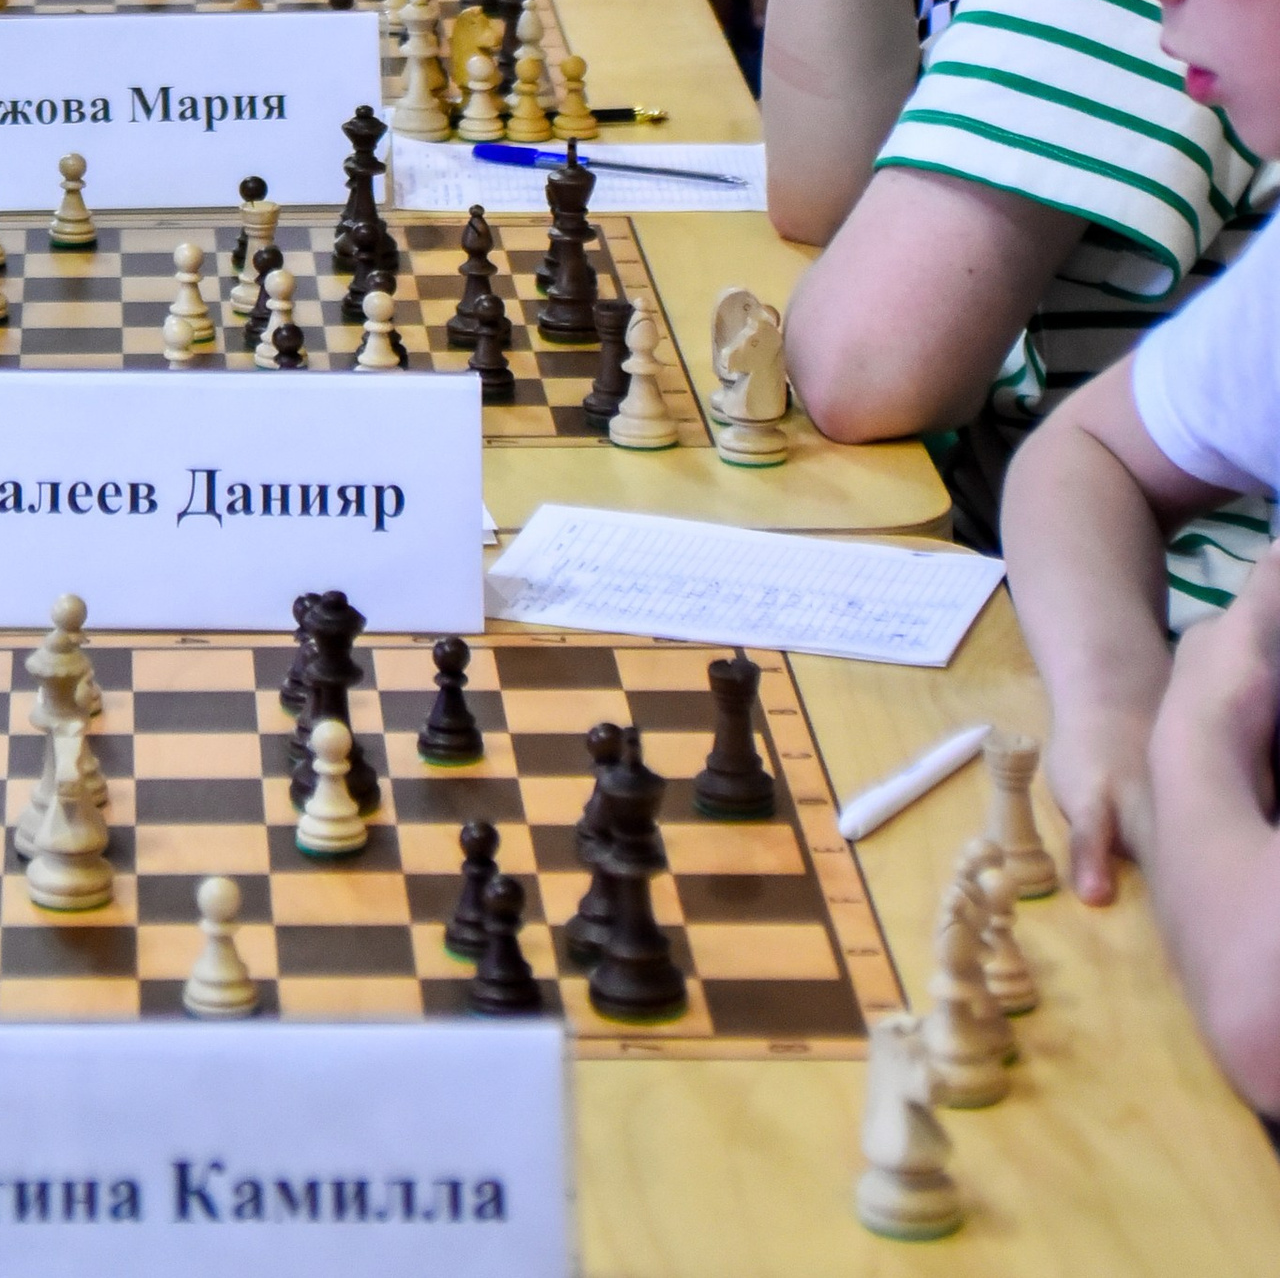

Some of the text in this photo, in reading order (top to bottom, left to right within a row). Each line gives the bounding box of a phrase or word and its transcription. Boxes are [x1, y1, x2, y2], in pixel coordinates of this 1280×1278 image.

[128, 85, 287, 132] Мария
[176, 467, 406, 532] Данияр
[170, 1157, 509, 1223] Камилла
